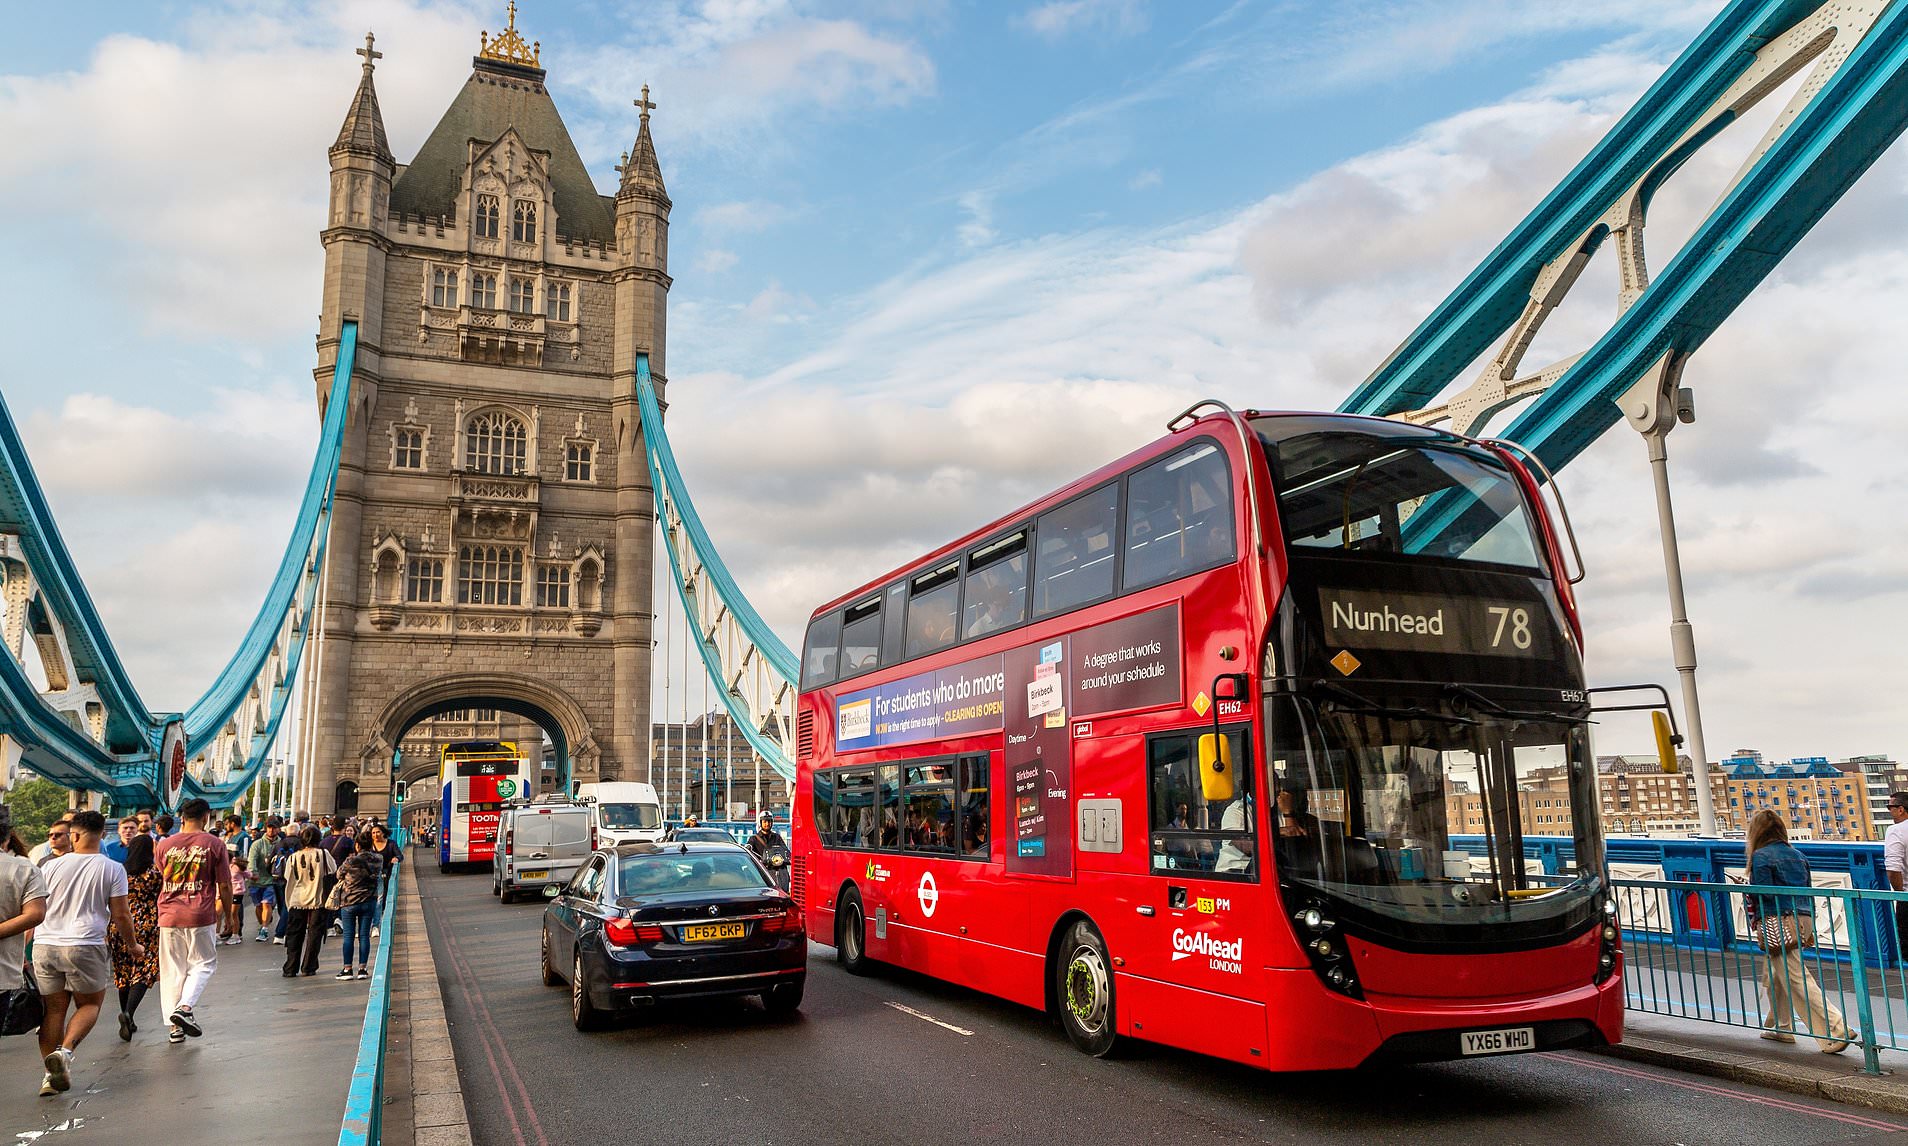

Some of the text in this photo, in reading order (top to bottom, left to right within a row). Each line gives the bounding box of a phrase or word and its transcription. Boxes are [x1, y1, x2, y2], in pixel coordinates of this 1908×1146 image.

[1331, 601, 1532, 649] Nunhead 78
[1083, 639, 1161, 669] A degree that works
[1081, 661, 1166, 691] around your schedule
[875, 671, 1005, 717] For students who do more
[1030, 684, 1054, 700] Birkbeck
[1560, 690, 1585, 703] EH62
[1219, 701, 1242, 715] EH62
[887, 721, 892, 733] is
[891, 719, 900, 732] the
[899, 717, 910, 733] right
[910, 716, 921, 729] time
[921, 716, 927, 728] to
[926, 712, 941, 728] apply
[944, 705, 976, 723] CLEARING
[975, 704, 983, 717] IS
[1076, 724, 1089, 734] global
[1008, 734, 1027, 745] Daytime
[1016, 767, 1039, 782] Birkbeck
[1048, 788, 1067, 800] Evening
[1018, 818, 1031, 828] Lunch
[183, 879, 203, 891] PEARS
[1198, 897, 1231, 912] 153 PM
[687, 924, 742, 939] LF62 GKP
[1172, 927, 1243, 961] GoAhead
[1209, 958, 1242, 975] LONDON
[1466, 1030, 1529, 1051] YX66 WHD
